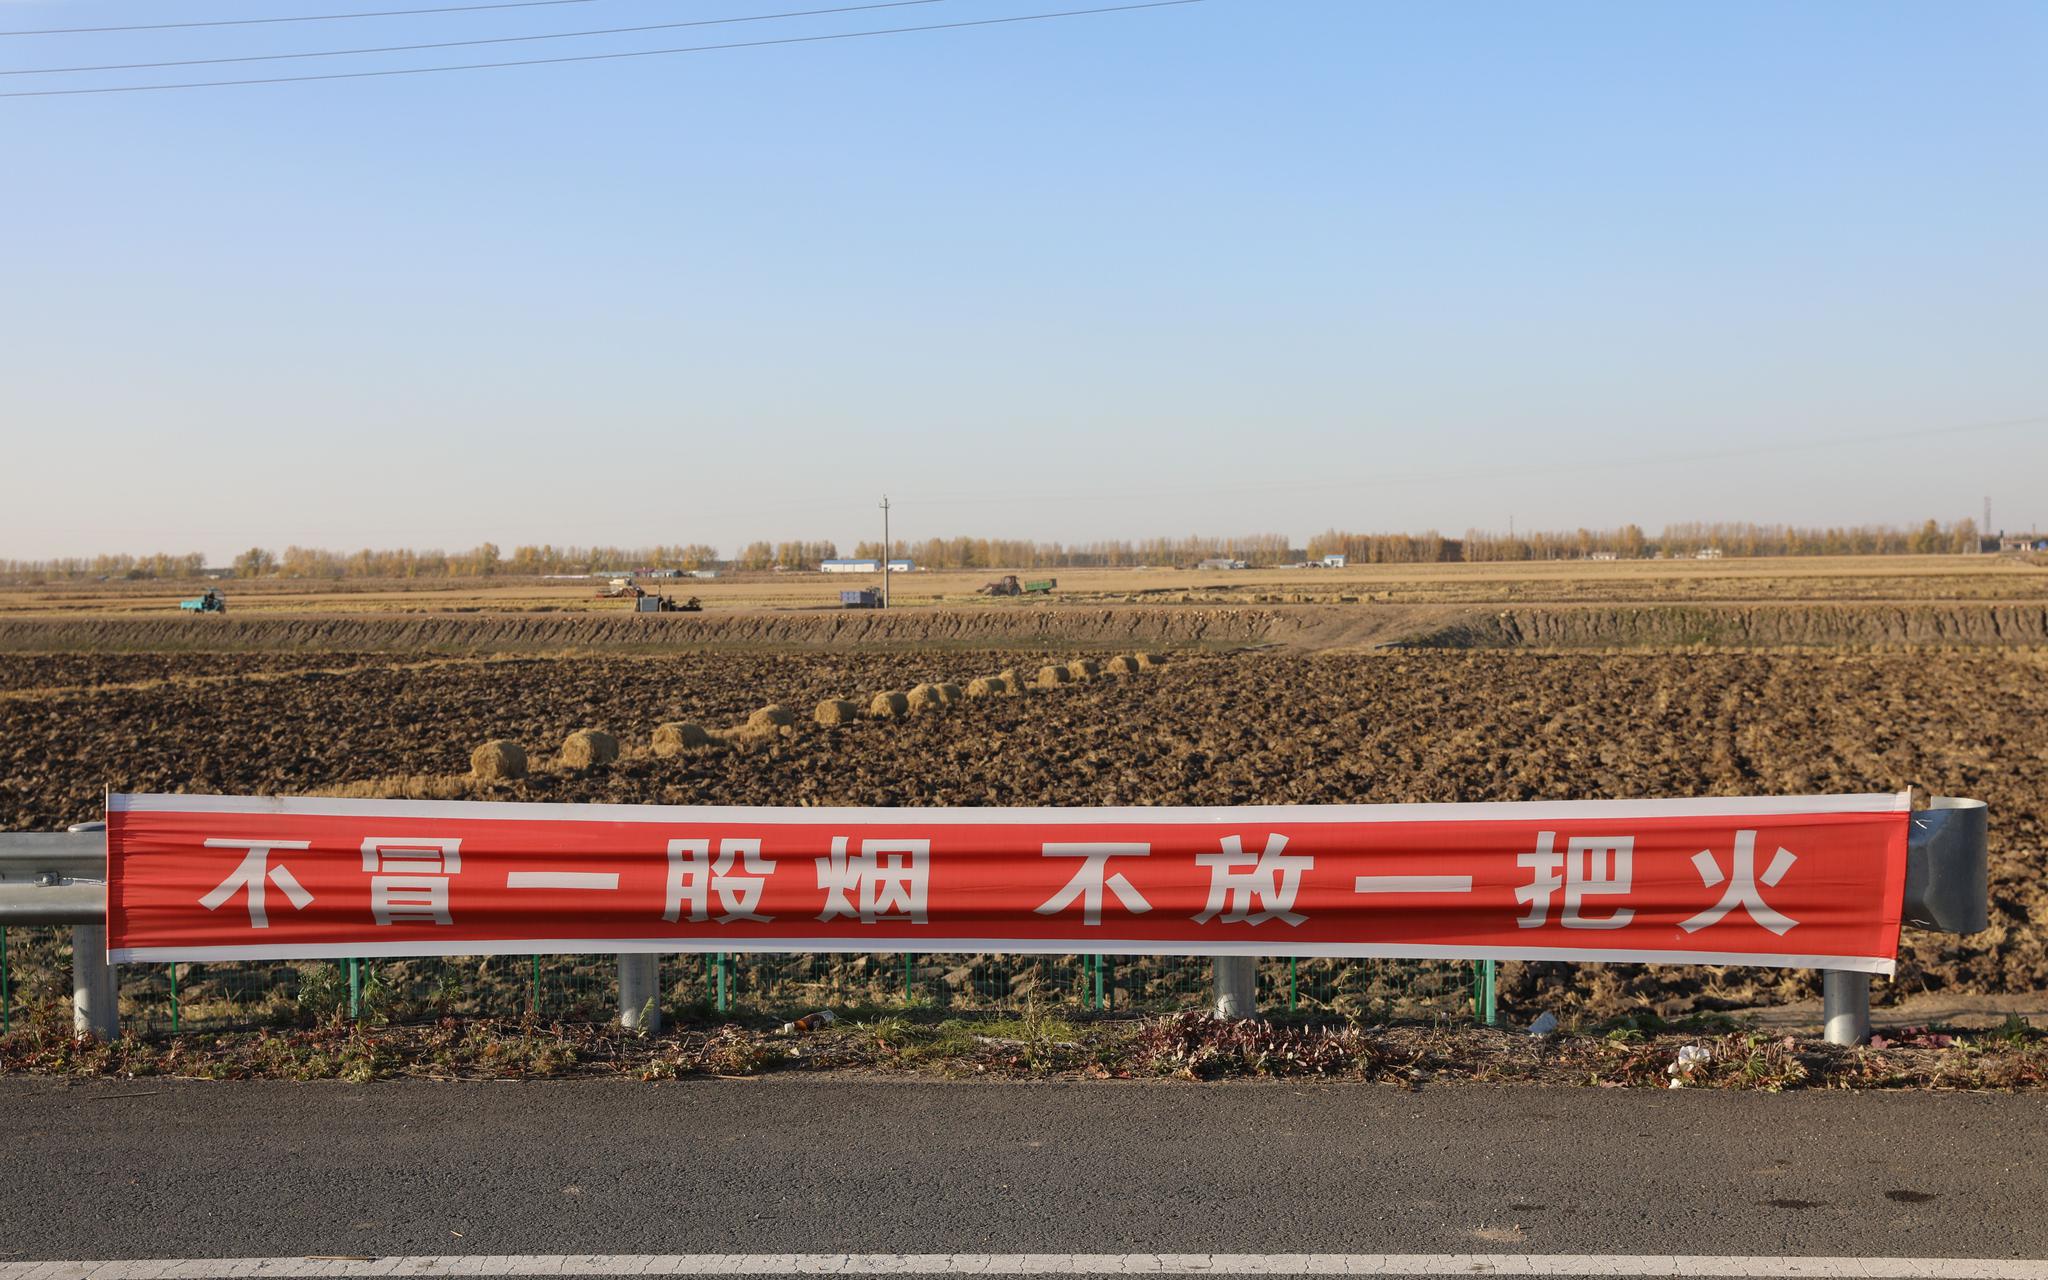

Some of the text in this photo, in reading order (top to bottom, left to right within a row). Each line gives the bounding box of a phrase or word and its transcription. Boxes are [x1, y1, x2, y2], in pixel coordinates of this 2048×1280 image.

[198, 829, 1800, 937] 不冒一股烟 不放一把火
